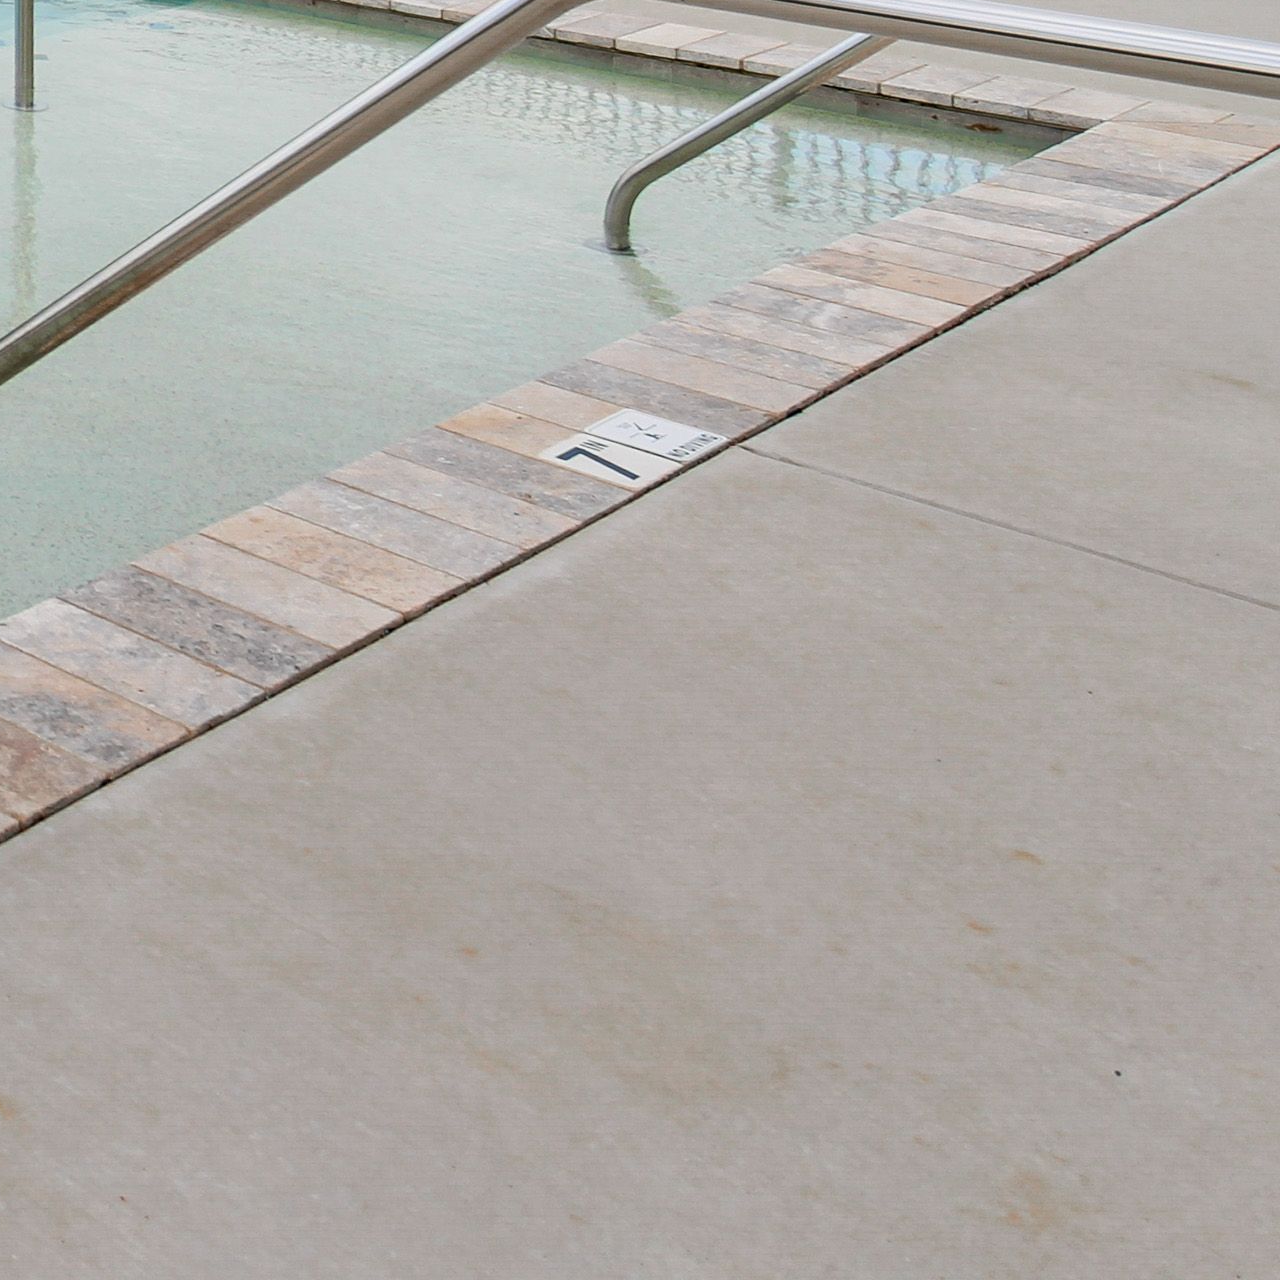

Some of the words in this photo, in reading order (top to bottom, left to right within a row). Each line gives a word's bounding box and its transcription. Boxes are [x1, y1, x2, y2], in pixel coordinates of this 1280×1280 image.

[578, 438, 609, 452] IN
[666, 448, 691, 458] NO
[556, 446, 641, 481] 7
